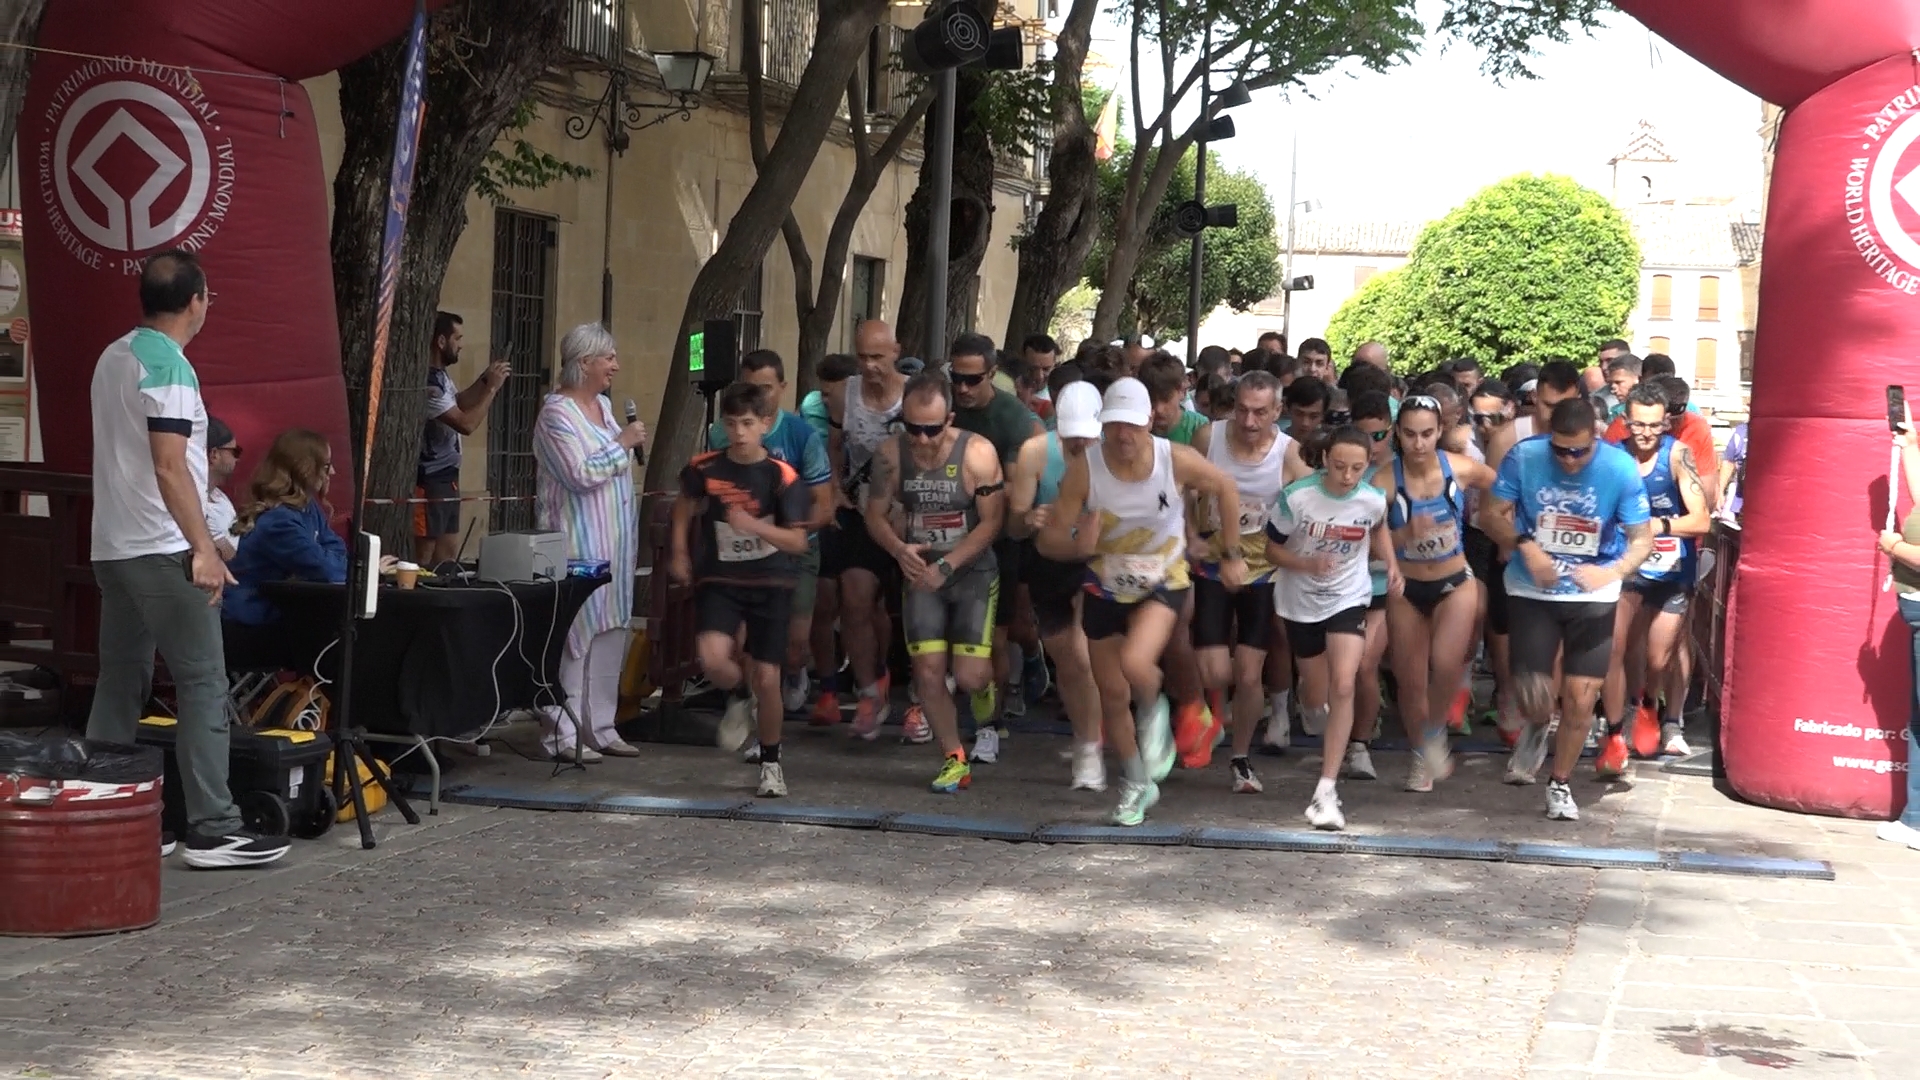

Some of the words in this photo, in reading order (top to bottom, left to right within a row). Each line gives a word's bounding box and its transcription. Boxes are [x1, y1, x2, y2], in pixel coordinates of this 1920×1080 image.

[46, 55, 134, 124] PATRIMONIO
[138, 57, 220, 126] MUNDIAL
[208, 137, 236, 222] MONDIAL
[1845, 157, 1870, 224] WORLD
[38, 140, 54, 205] WORLD
[49, 206, 104, 271] HERITAGE
[1850, 223, 1920, 296] HERITAGE
[917, 491, 950, 503] TEAM
[927, 529, 947, 542] 31
[1315, 539, 1351, 554] 228
[1551, 530, 1587, 546] 100
[1794, 718, 1862, 738] Fabricado
[1864, 727, 1896, 741] por:
